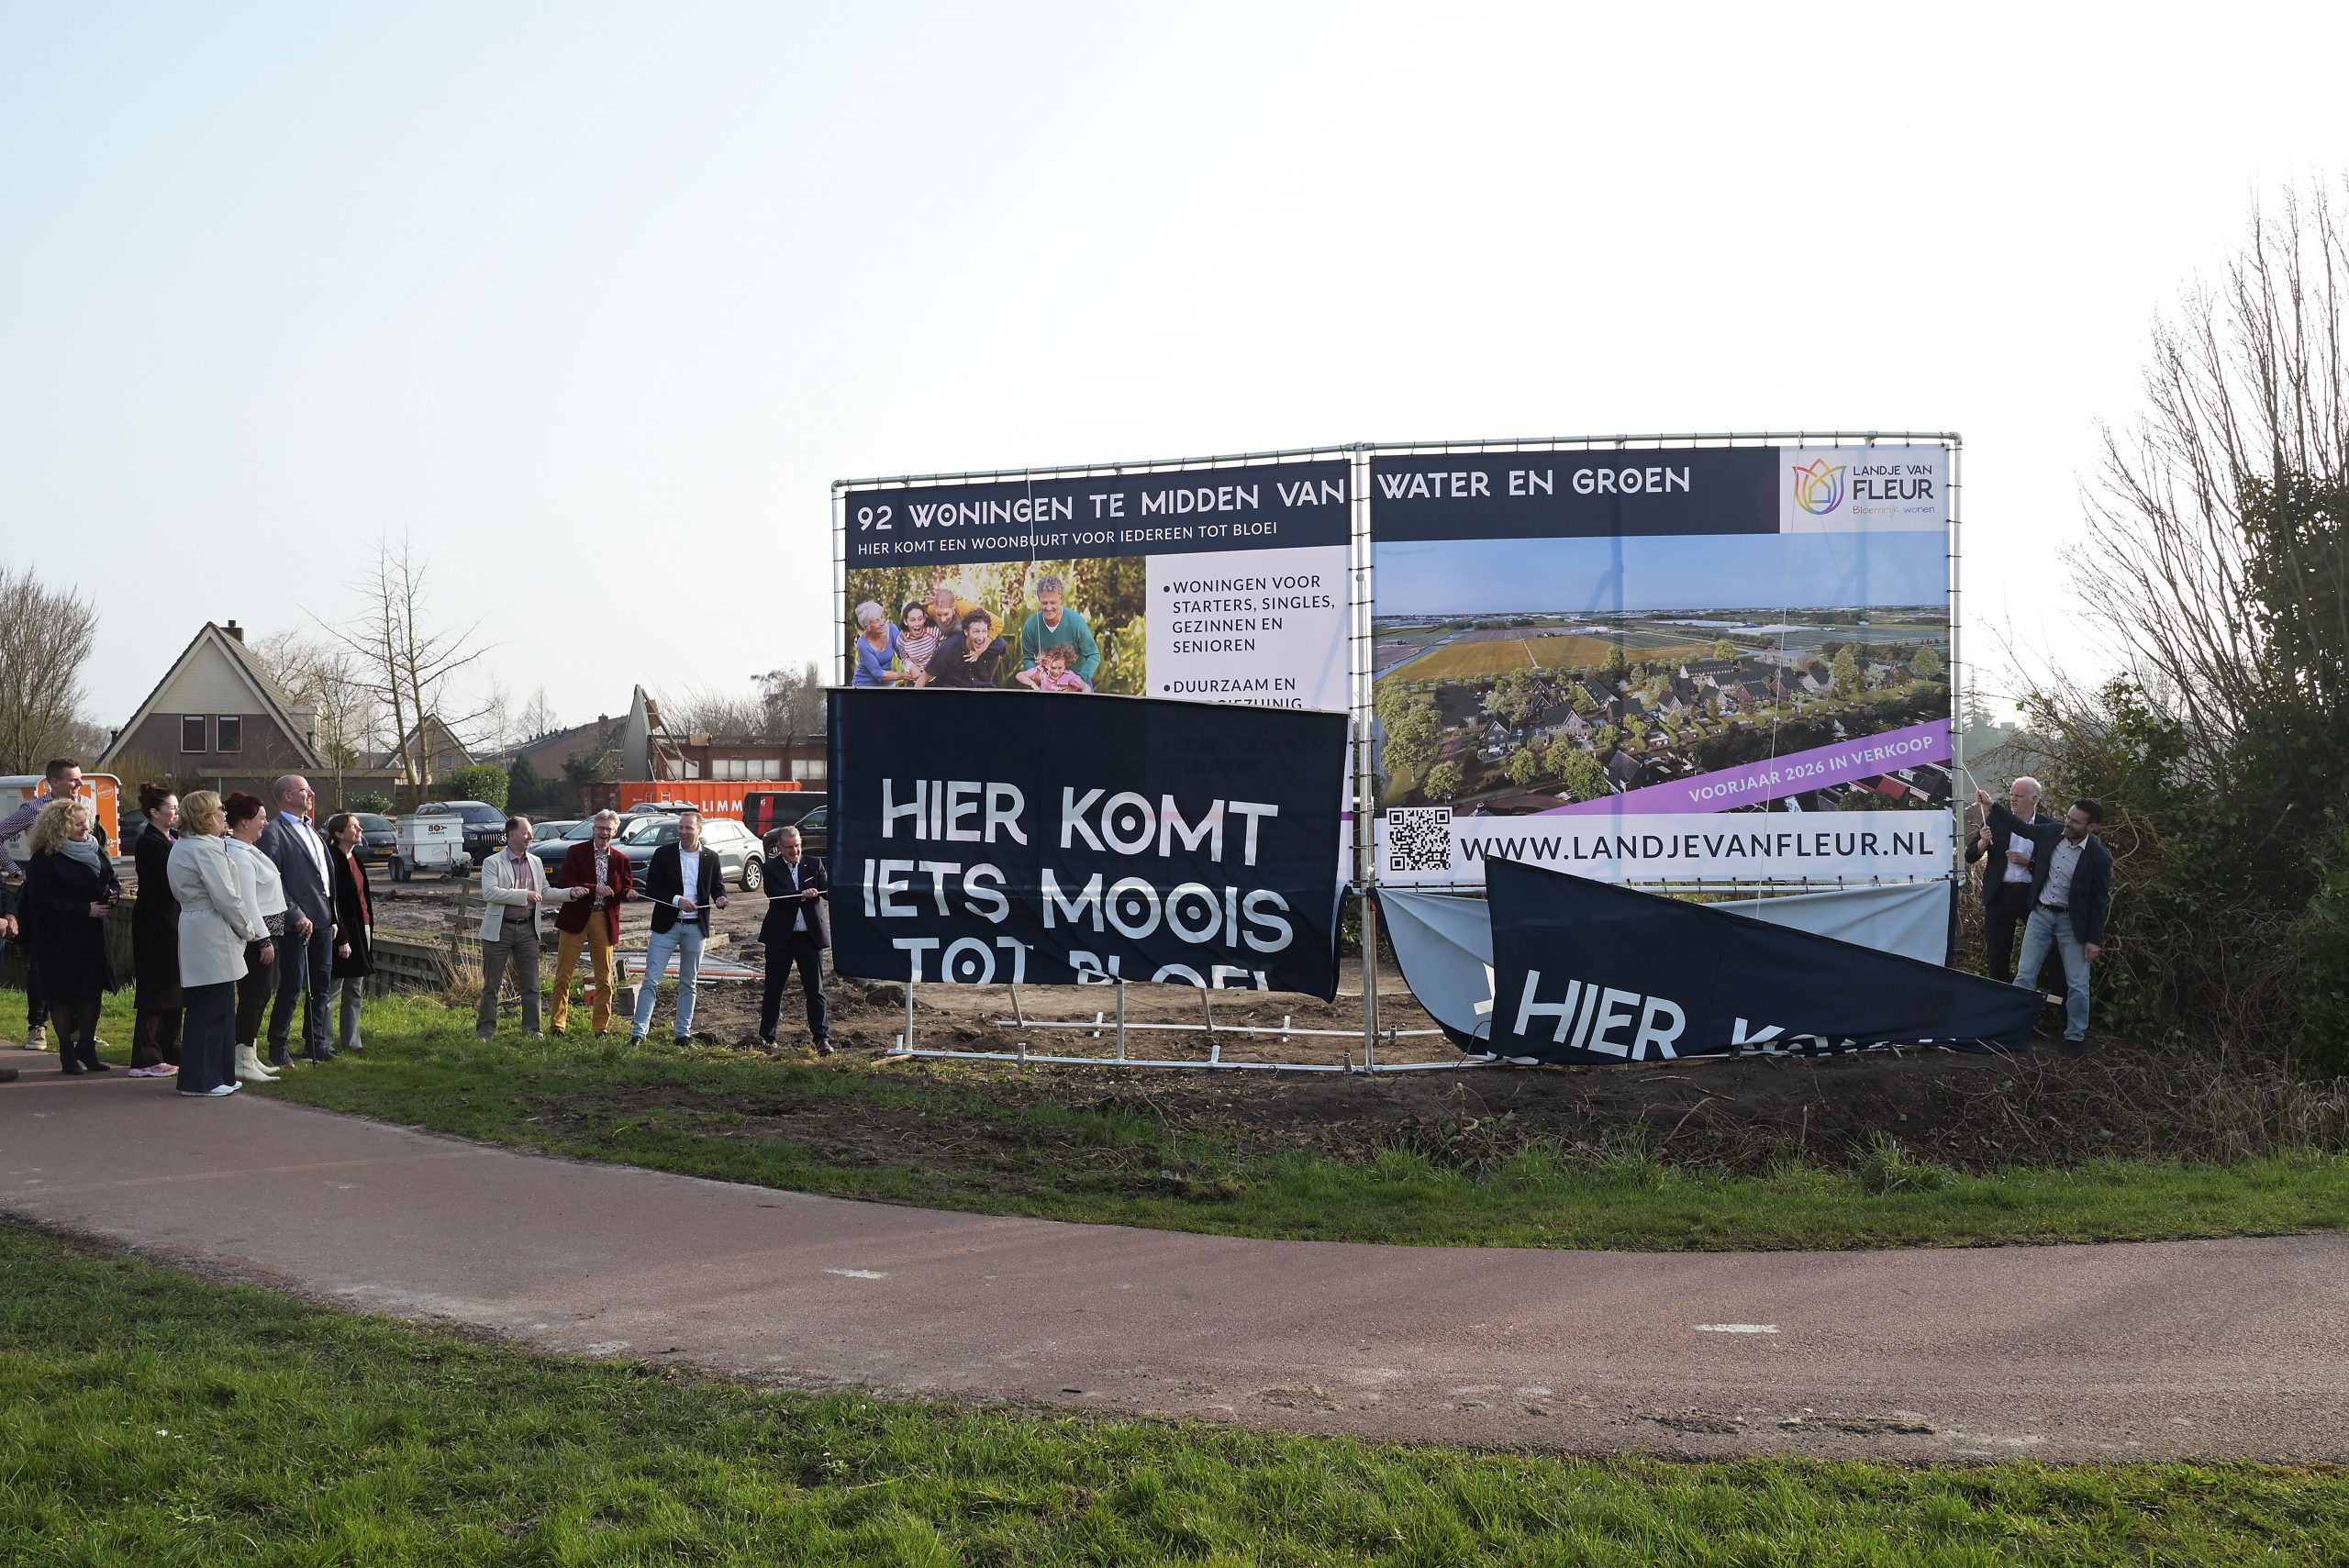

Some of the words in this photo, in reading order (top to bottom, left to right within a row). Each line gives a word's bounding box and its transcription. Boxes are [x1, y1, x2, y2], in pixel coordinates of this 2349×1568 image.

[1854, 466, 1900, 475] LANDJE
[1907, 465, 1932, 475] VAN
[1377, 472, 1490, 498] WATER
[1509, 470, 1553, 496] EN
[1573, 467, 1689, 495] GROEN
[1854, 479, 1933, 500] FLEUR
[858, 506, 893, 531] 92
[908, 496, 1073, 528] WONINGEN
[1089, 494, 1124, 518] TE
[1142, 485, 1259, 516] MIDDEN
[1277, 479, 1344, 507] VAN
[1854, 506, 1898, 517] Bloemrijk
[858, 542, 890, 555] HIER
[895, 539, 935, 554] KOMT
[941, 538, 967, 551] EEN
[971, 532, 1069, 550] WOONBUURT
[1073, 530, 1115, 545] VOOR
[1120, 526, 1193, 542] IEDEREEN
[1197, 524, 1229, 538] TOT
[1233, 521, 1277, 536] BLOEI
[1174, 578, 1266, 594] WONINGEN
[1273, 575, 1320, 589] VOOR
[1173, 598, 1256, 613] STARTERS,
[1263, 595, 1335, 609] SINGLES,
[1173, 618, 1255, 633] GEZINNEN
[1263, 617, 1283, 629] EN
[1173, 639, 1255, 653] SENIOREN
[1174, 679, 1268, 693] DUURZAAM
[1275, 678, 1296, 690] EN
[1688, 772, 1781, 802] VOORJAAR
[1786, 762, 1824, 781] 2026
[1830, 755, 1848, 771] IN
[1851, 736, 1933, 765] VERKOOP
[703, 800, 742, 813] LIMM
[881, 778, 1028, 846] HIER
[1060, 786, 1278, 866] KOMT
[1461, 830, 1933, 862] WWW.LANDJEVANFLEUR.NL
[863, 858, 1010, 924] IETS
[1041, 868, 1294, 952] MOOIS
[1513, 969, 1687, 1061] HIER
